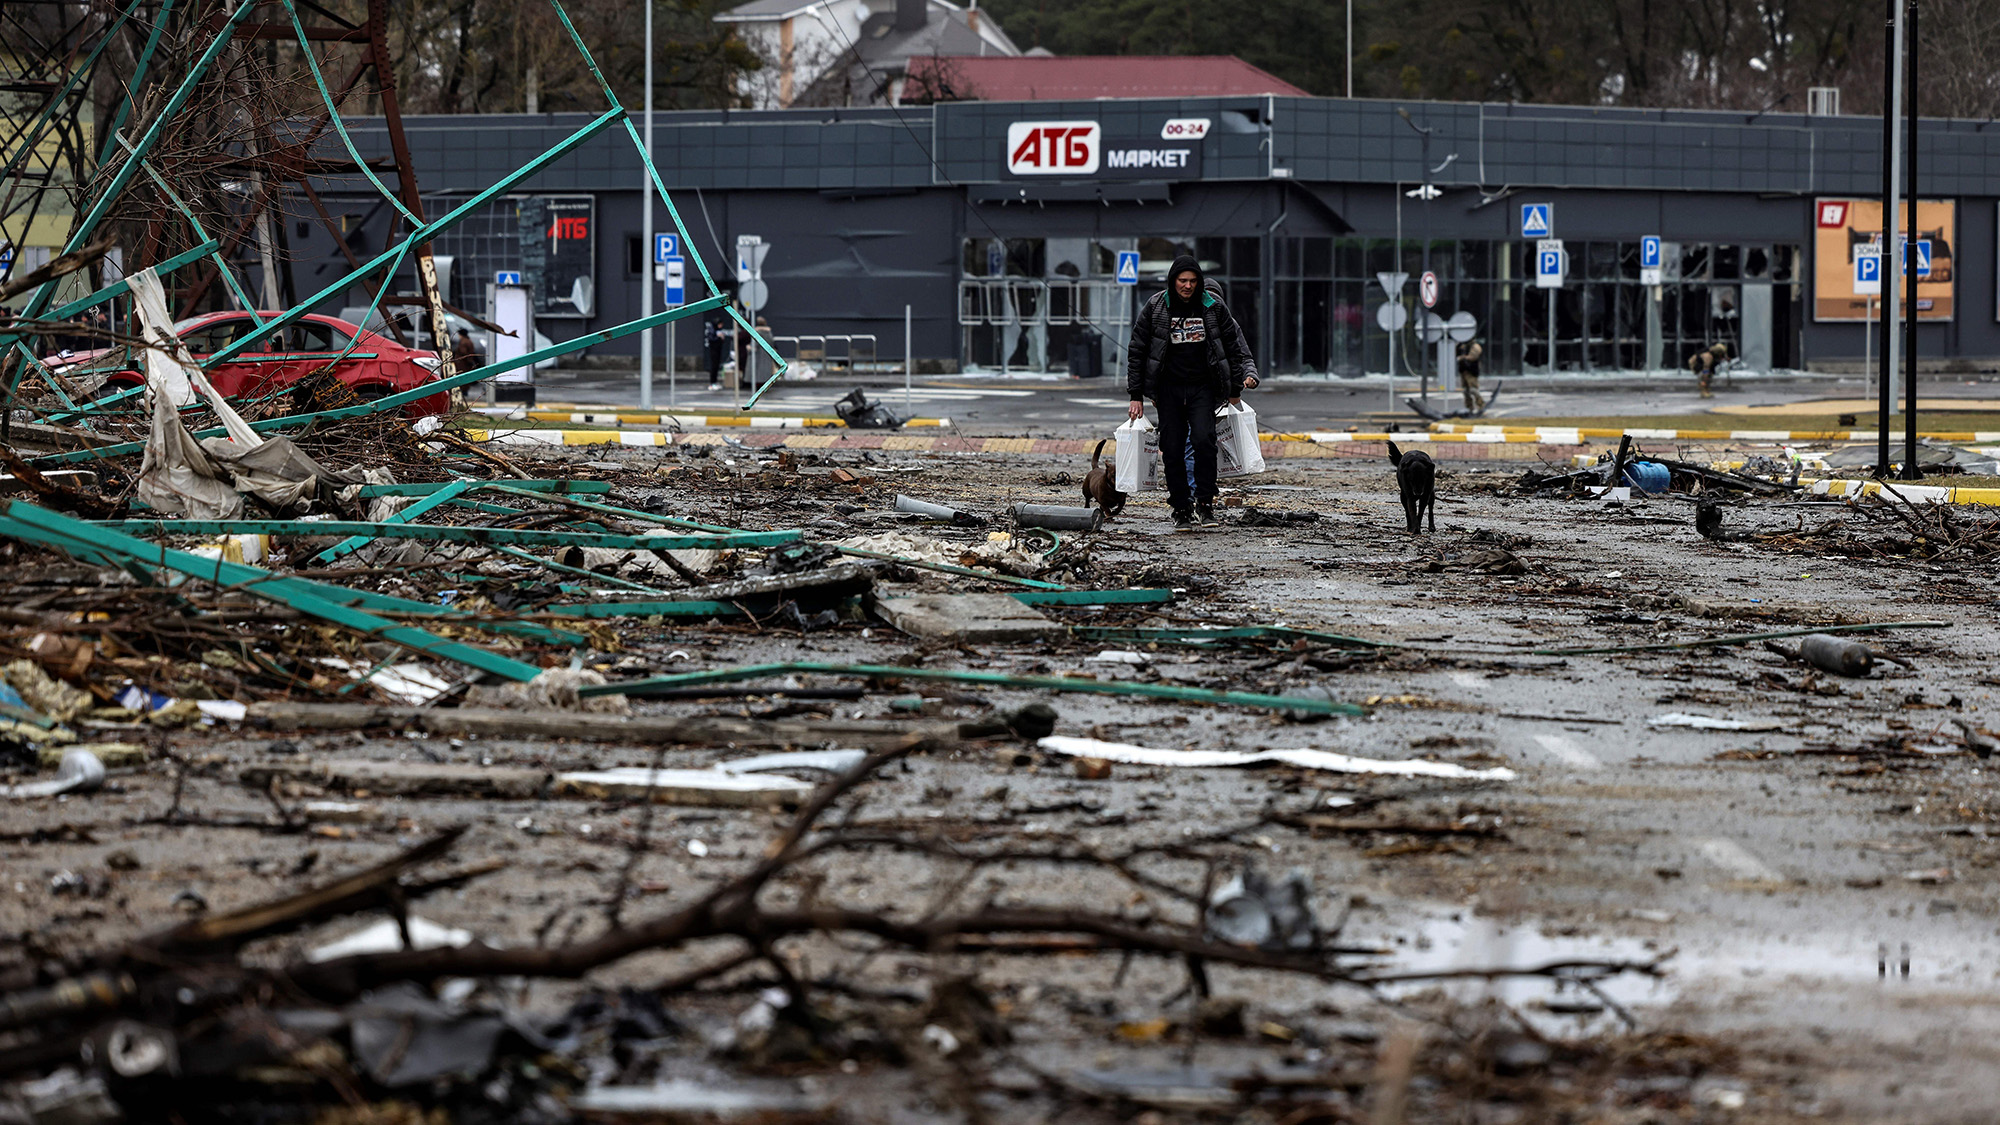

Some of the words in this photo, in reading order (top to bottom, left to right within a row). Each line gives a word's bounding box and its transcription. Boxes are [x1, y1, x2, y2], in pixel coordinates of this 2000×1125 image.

[1167, 124, 1203, 134] 00-24
[1012, 127, 1093, 167] АТБ
[1107, 149, 1191, 168] МАРКЕТ
[547, 217, 588, 239] АТБ
